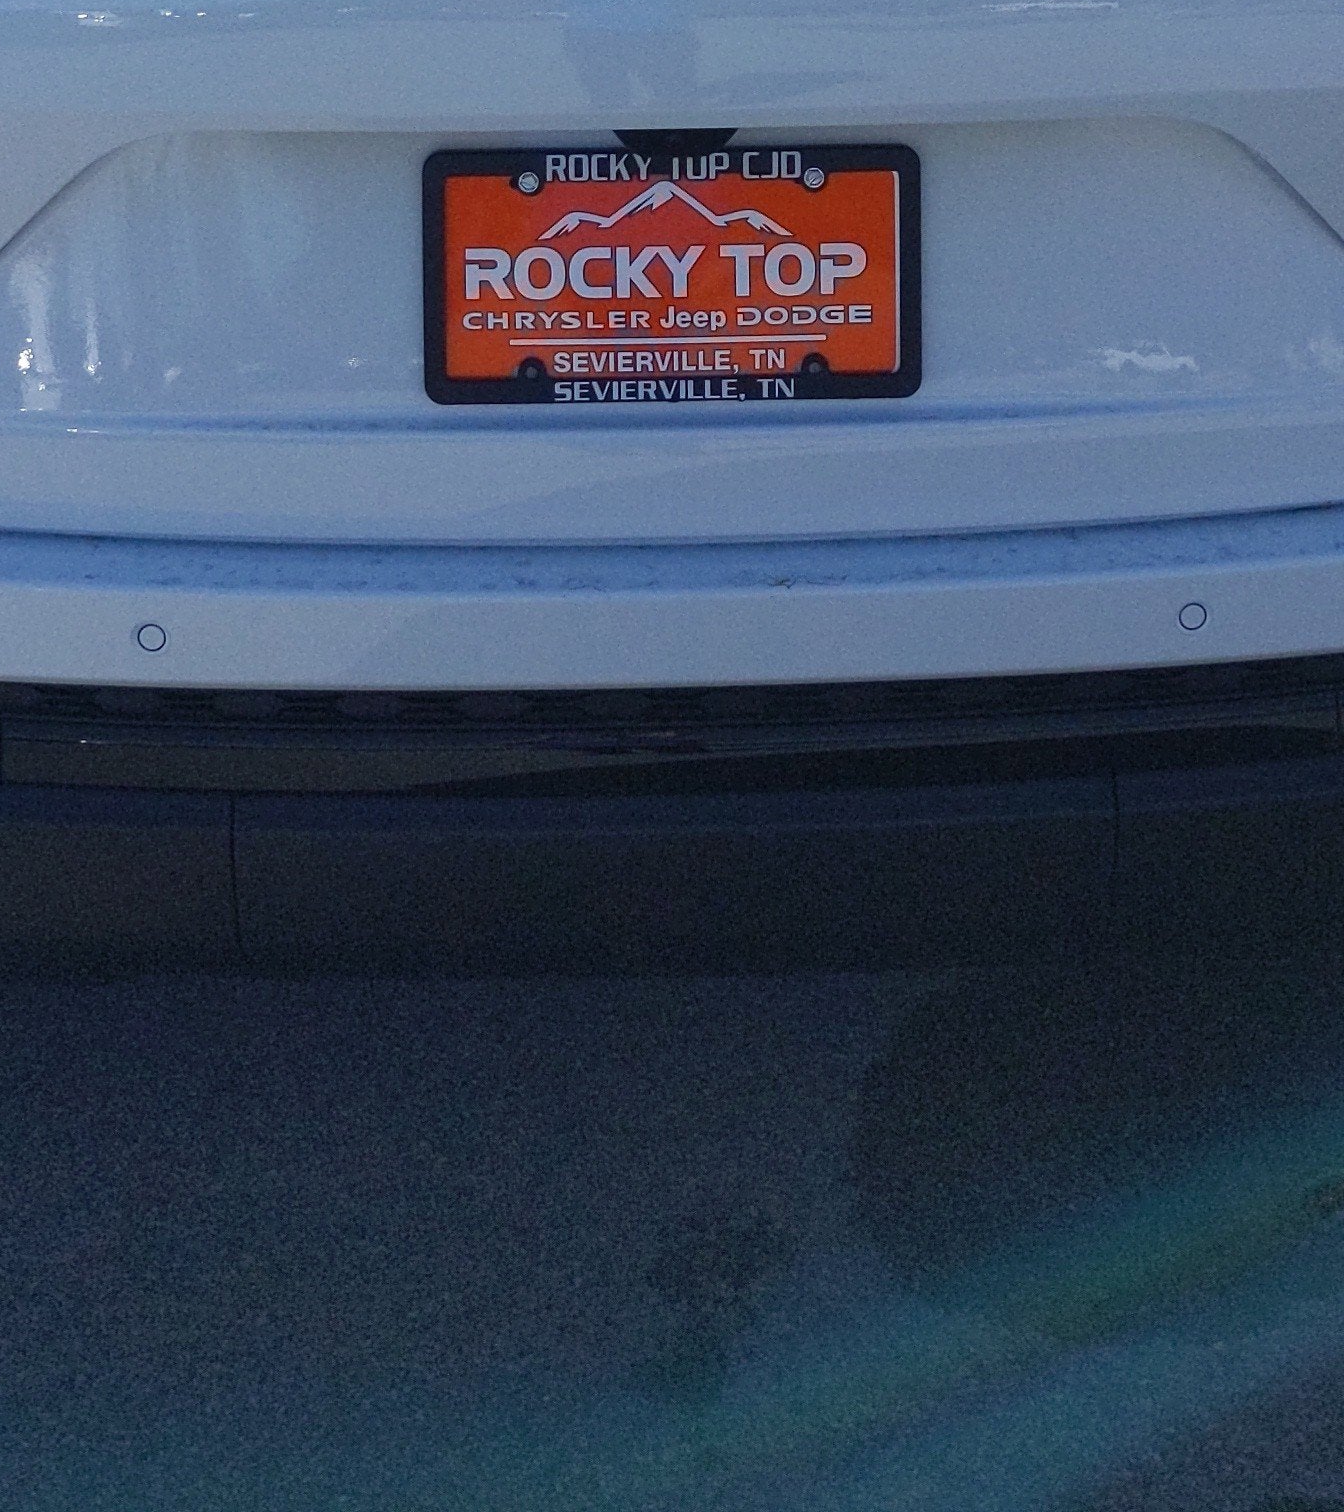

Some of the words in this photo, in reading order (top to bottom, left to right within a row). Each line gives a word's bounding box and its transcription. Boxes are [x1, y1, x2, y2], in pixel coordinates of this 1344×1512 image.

[545, 153, 652, 182] ROCKY
[742, 151, 802, 179] CJD
[464, 245, 705, 300] ROCKY
[719, 243, 868, 297] TOP
[462, 309, 651, 331] CHRYSLER
[660, 306, 727, 331] Jeep
[737, 304, 872, 326] DODGE
[553, 349, 739, 375] SEVIERVILLE,
[749, 348, 786, 370] TN
[554, 379, 746, 401] SEVIERVILLE,
[757, 378, 795, 399] TN
